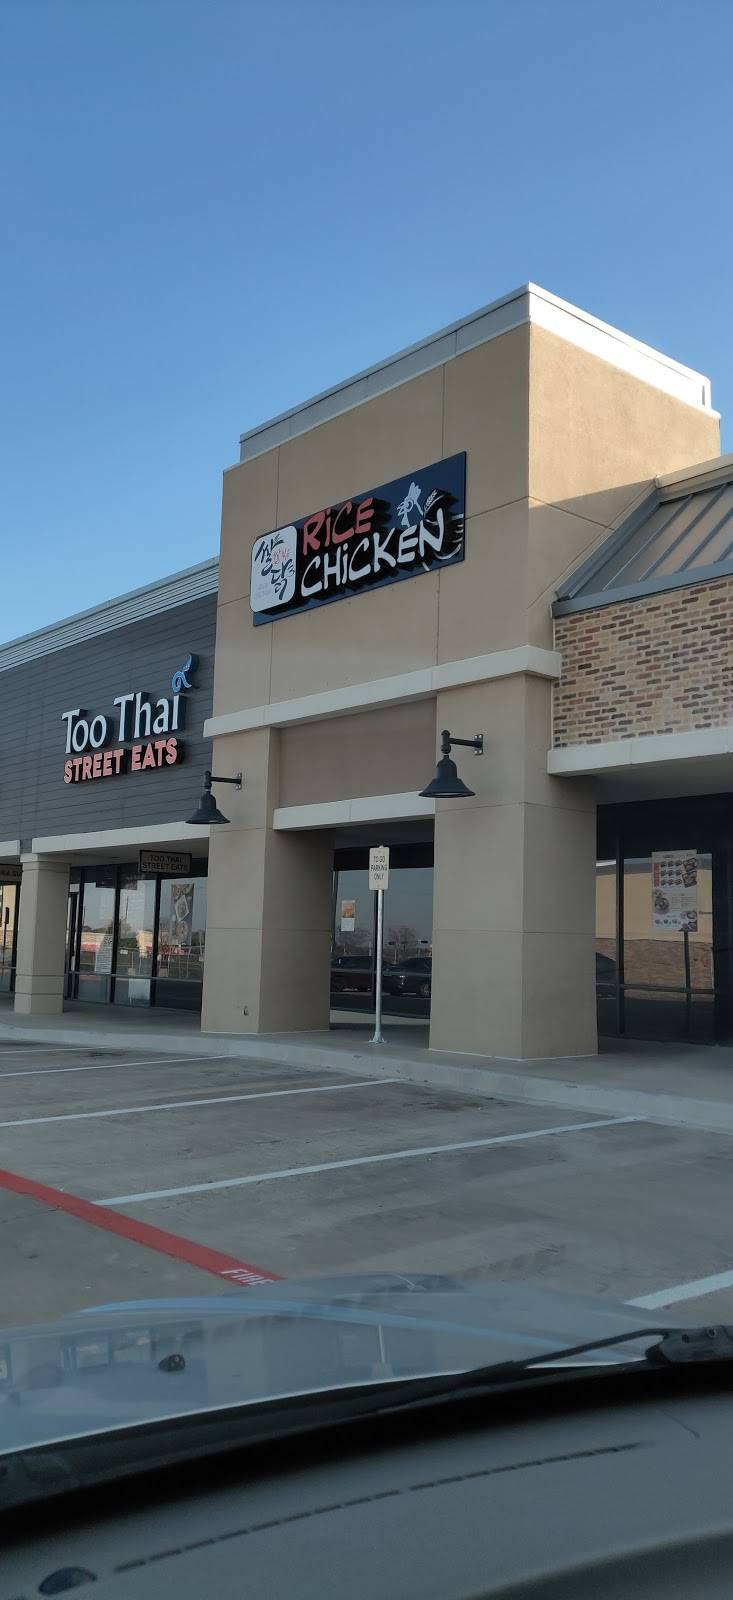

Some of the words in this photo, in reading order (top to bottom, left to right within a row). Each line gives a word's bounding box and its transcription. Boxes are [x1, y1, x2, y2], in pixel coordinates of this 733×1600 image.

[61, 709, 107, 754] Too
[113, 692, 180, 742] Thai
[63, 749, 124, 784] STREET
[131, 738, 178, 771] EATS
[142, 862, 169, 870] STREET
